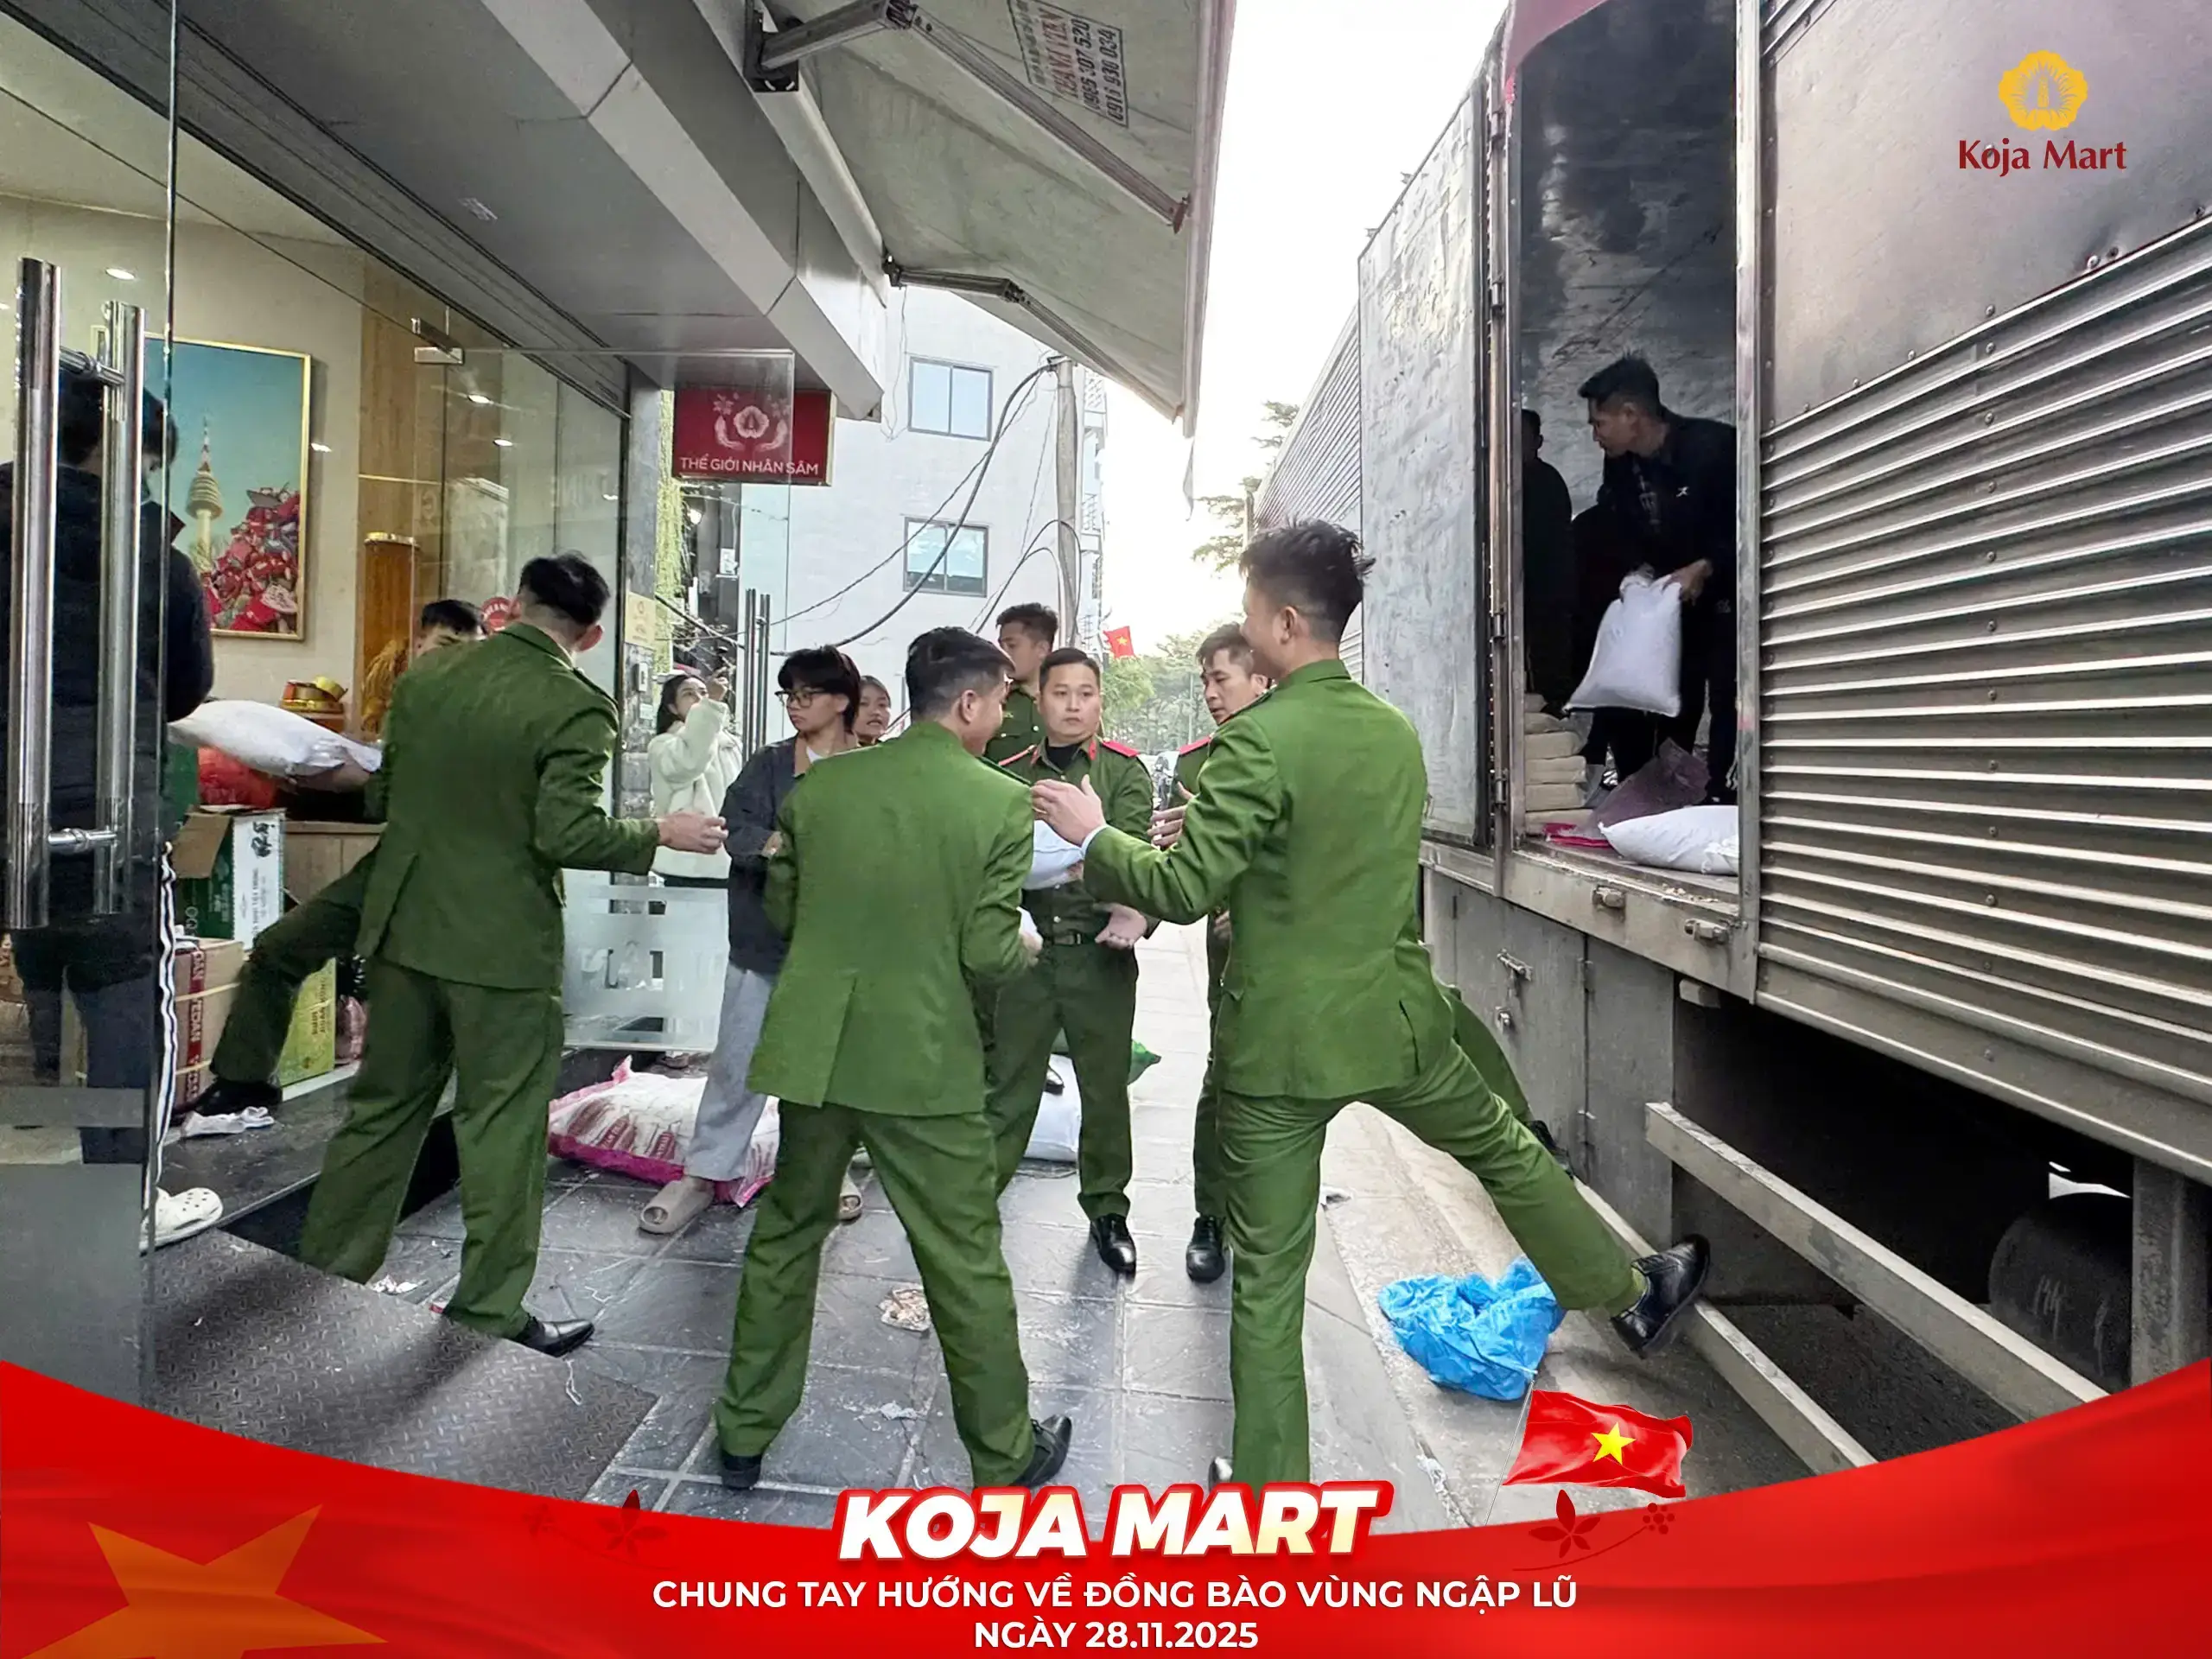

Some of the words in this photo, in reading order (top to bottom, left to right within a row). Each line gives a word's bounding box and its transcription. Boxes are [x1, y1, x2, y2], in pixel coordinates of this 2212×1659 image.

[1071, 18, 1092, 49] 520
[1097, 28, 1119, 60] 034
[1076, 48, 1096, 76] 307
[1101, 60, 1122, 87] 930
[680, 453, 709, 471] THẾ
[710, 456, 740, 472] GIỚI
[742, 460, 785, 474] NHÂN
[786, 461, 819, 475] SÂM
